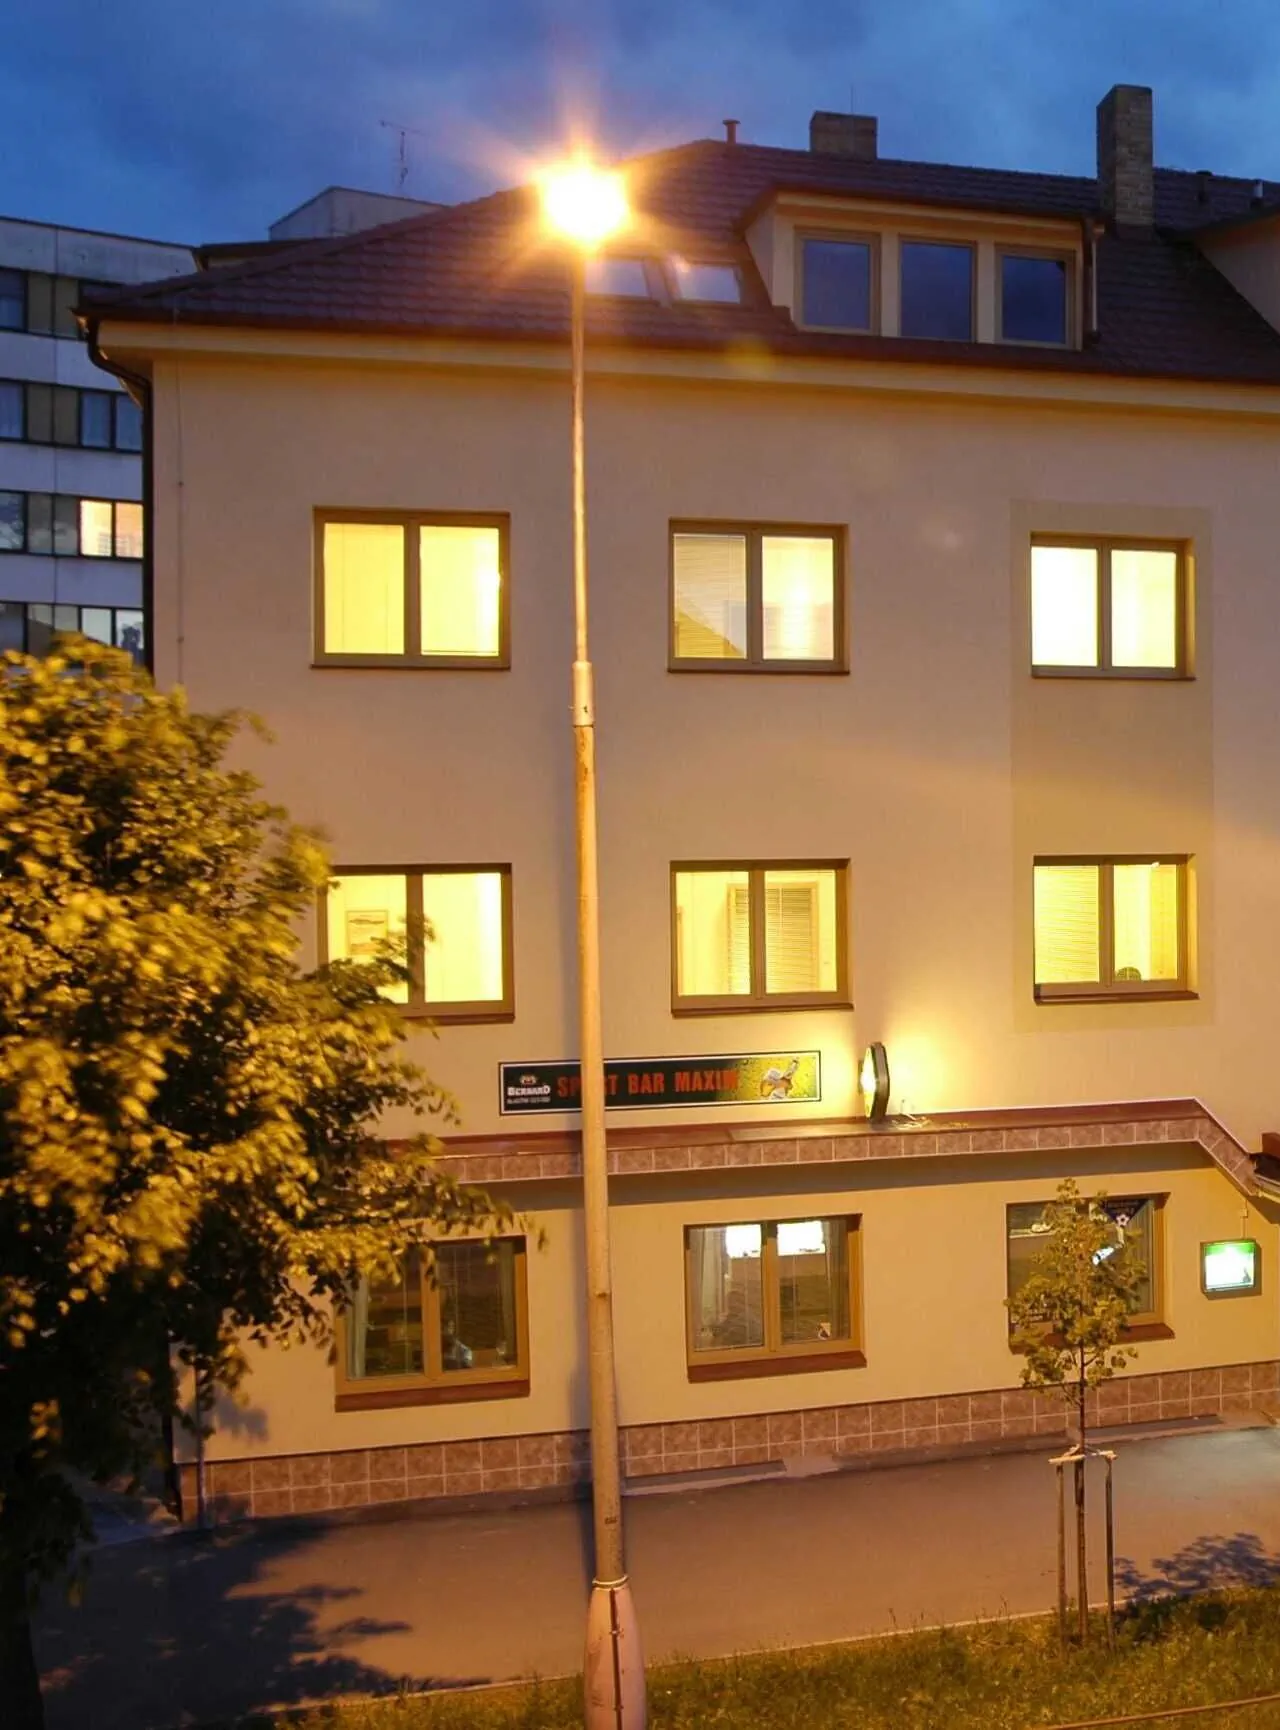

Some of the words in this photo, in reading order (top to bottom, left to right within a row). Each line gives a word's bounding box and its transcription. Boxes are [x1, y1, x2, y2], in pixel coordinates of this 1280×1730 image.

[557, 1074, 619, 1098] SPT
[627, 1072, 665, 1095] BAR
[674, 1068, 739, 1092] MAXIM
